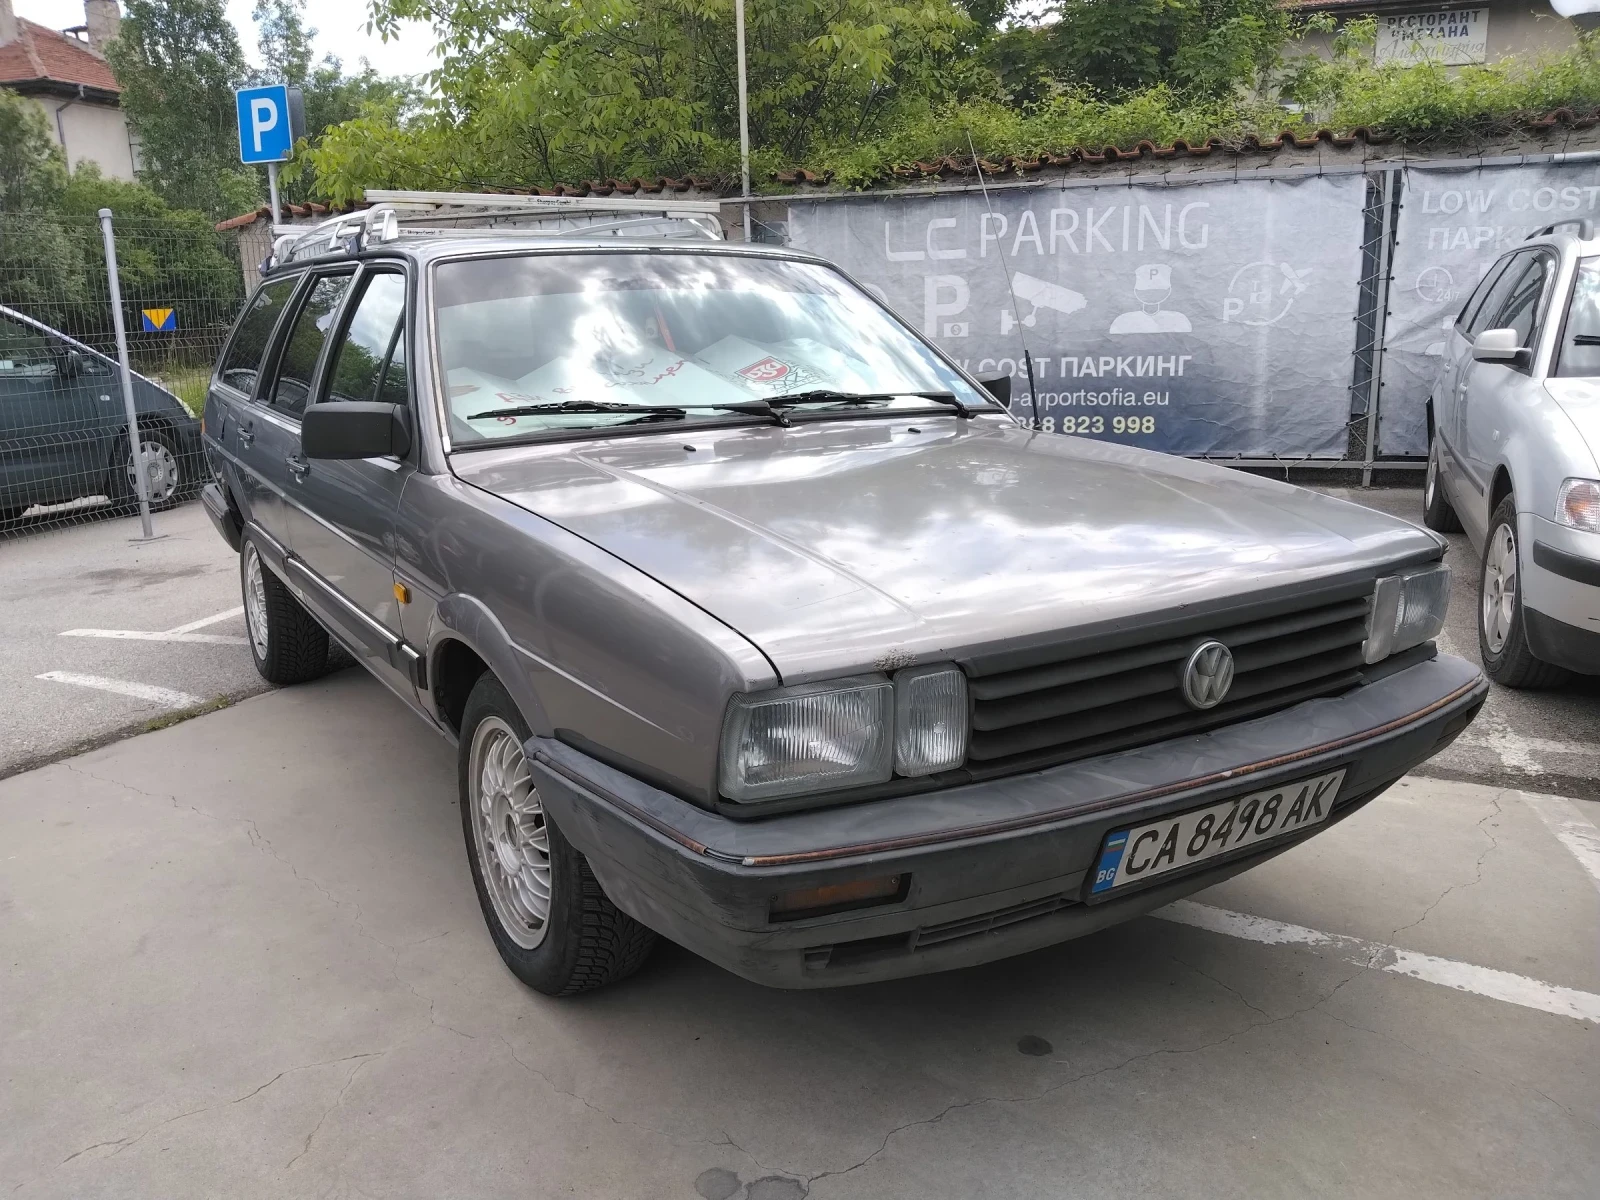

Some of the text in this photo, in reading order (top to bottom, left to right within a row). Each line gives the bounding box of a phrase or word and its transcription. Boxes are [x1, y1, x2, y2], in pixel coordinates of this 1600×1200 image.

[250, 97, 278, 152] P
[1421, 186, 1600, 214] LOW COST
[980, 202, 1210, 257] PARKING
[1436, 288, 1460, 302] 24/7
[1060, 355, 1192, 378] ПАРКИНГ
[1063, 415, 1104, 434] 823
[1112, 415, 1155, 434] 998
[1096, 867, 1116, 884] BG
[1186, 793, 1283, 857] 8498
